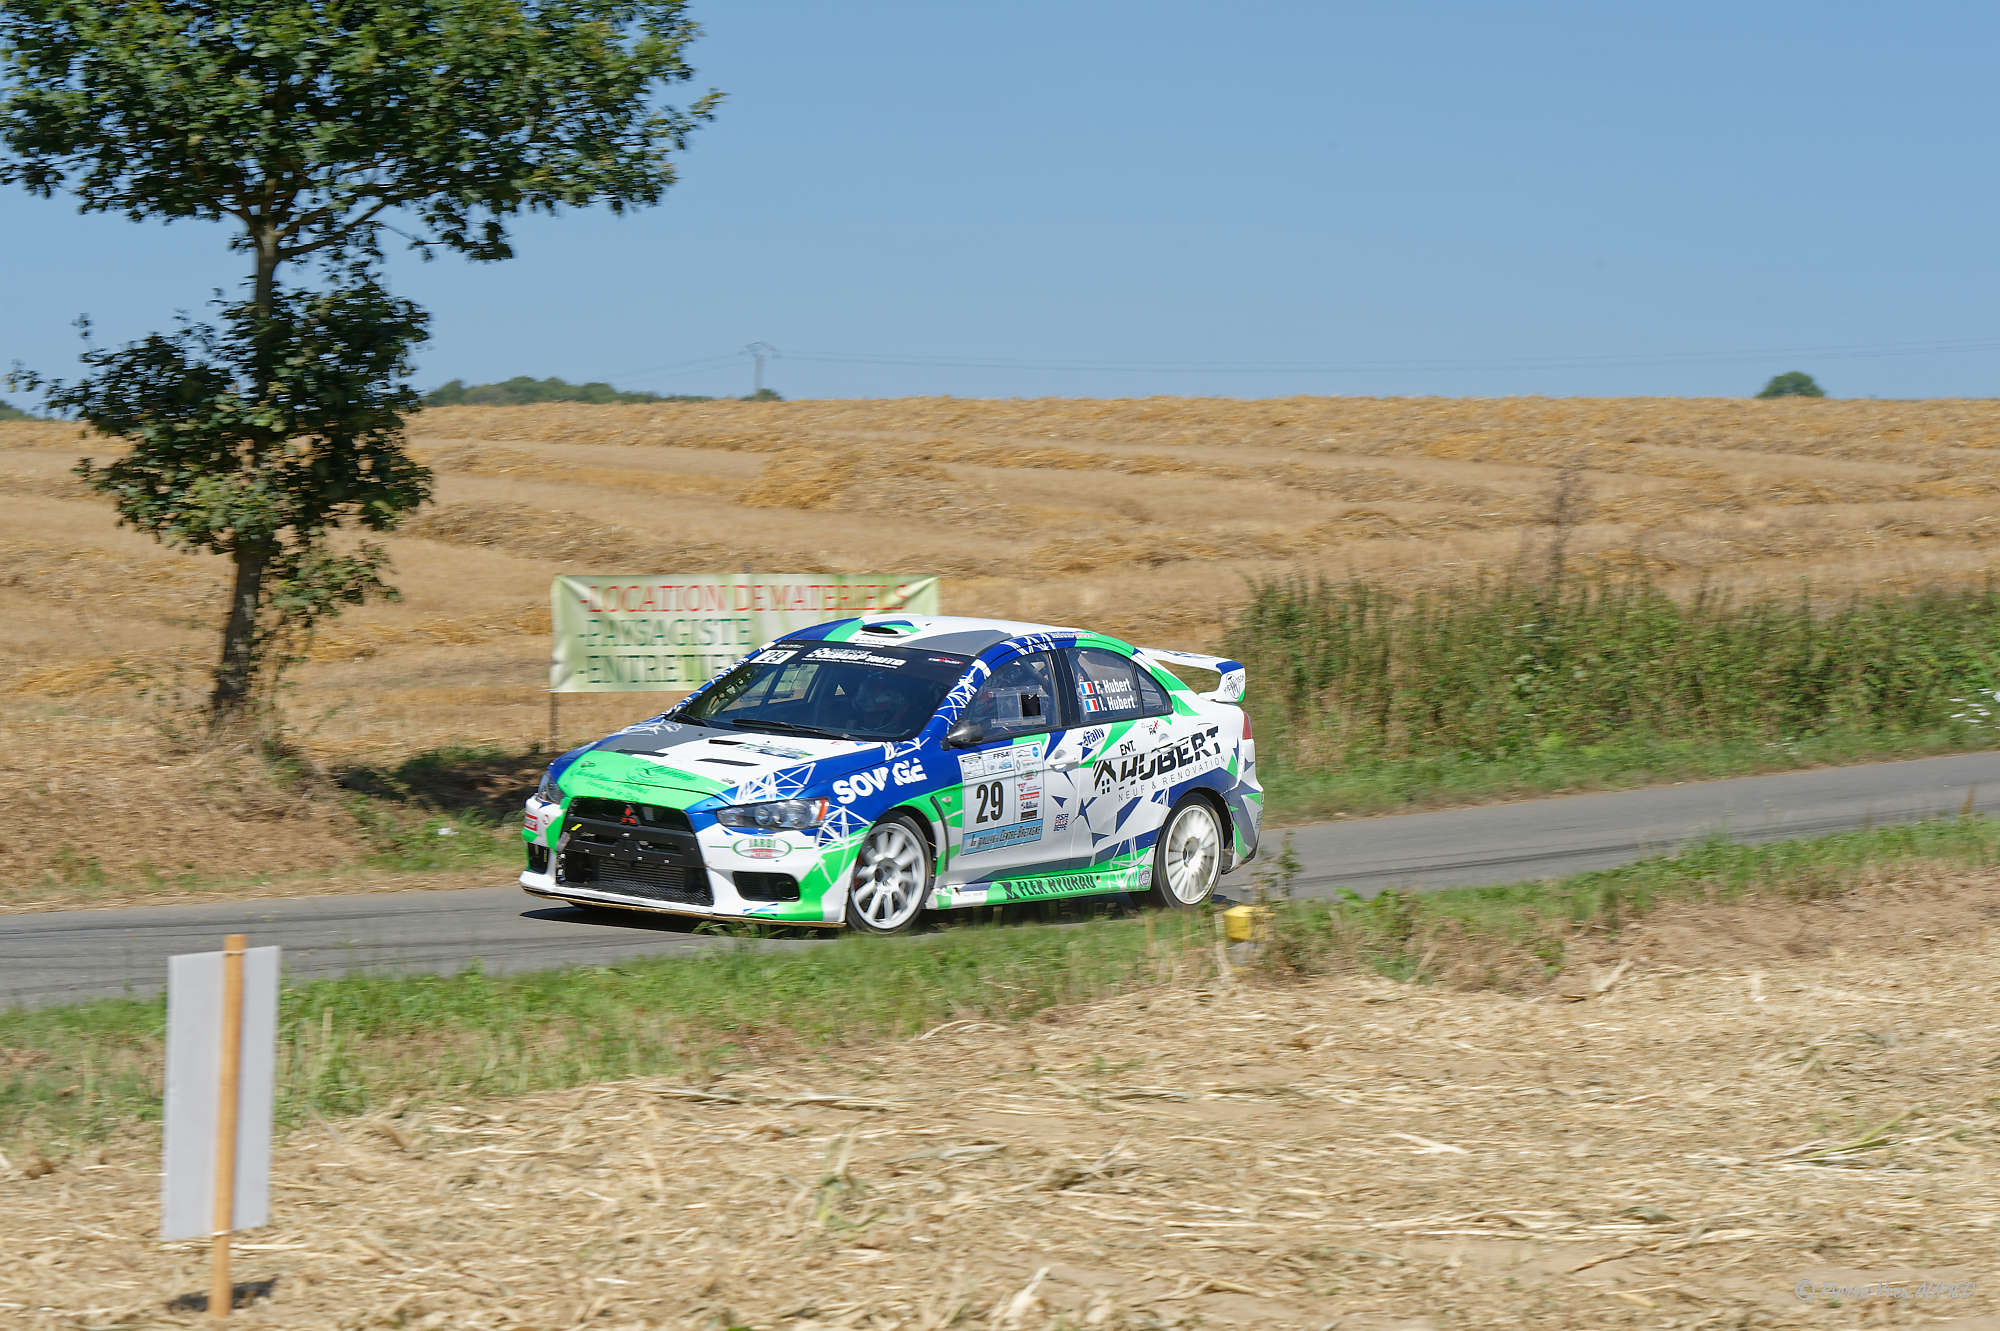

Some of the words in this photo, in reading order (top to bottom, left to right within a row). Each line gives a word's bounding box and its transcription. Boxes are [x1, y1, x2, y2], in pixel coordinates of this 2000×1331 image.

[733, 584, 764, 611] DE
[1104, 678, 1132, 693] Hubert
[1107, 695, 1136, 711] Hubert
[1118, 785, 1145, 801] NEUF
[1151, 782, 1157, 790] &
[1162, 755, 1226, 785] RENOVATION
[975, 781, 1004, 824] 29
[1016, 878, 1044, 897] FLEX
[1049, 874, 1096, 893] HYDRAU
